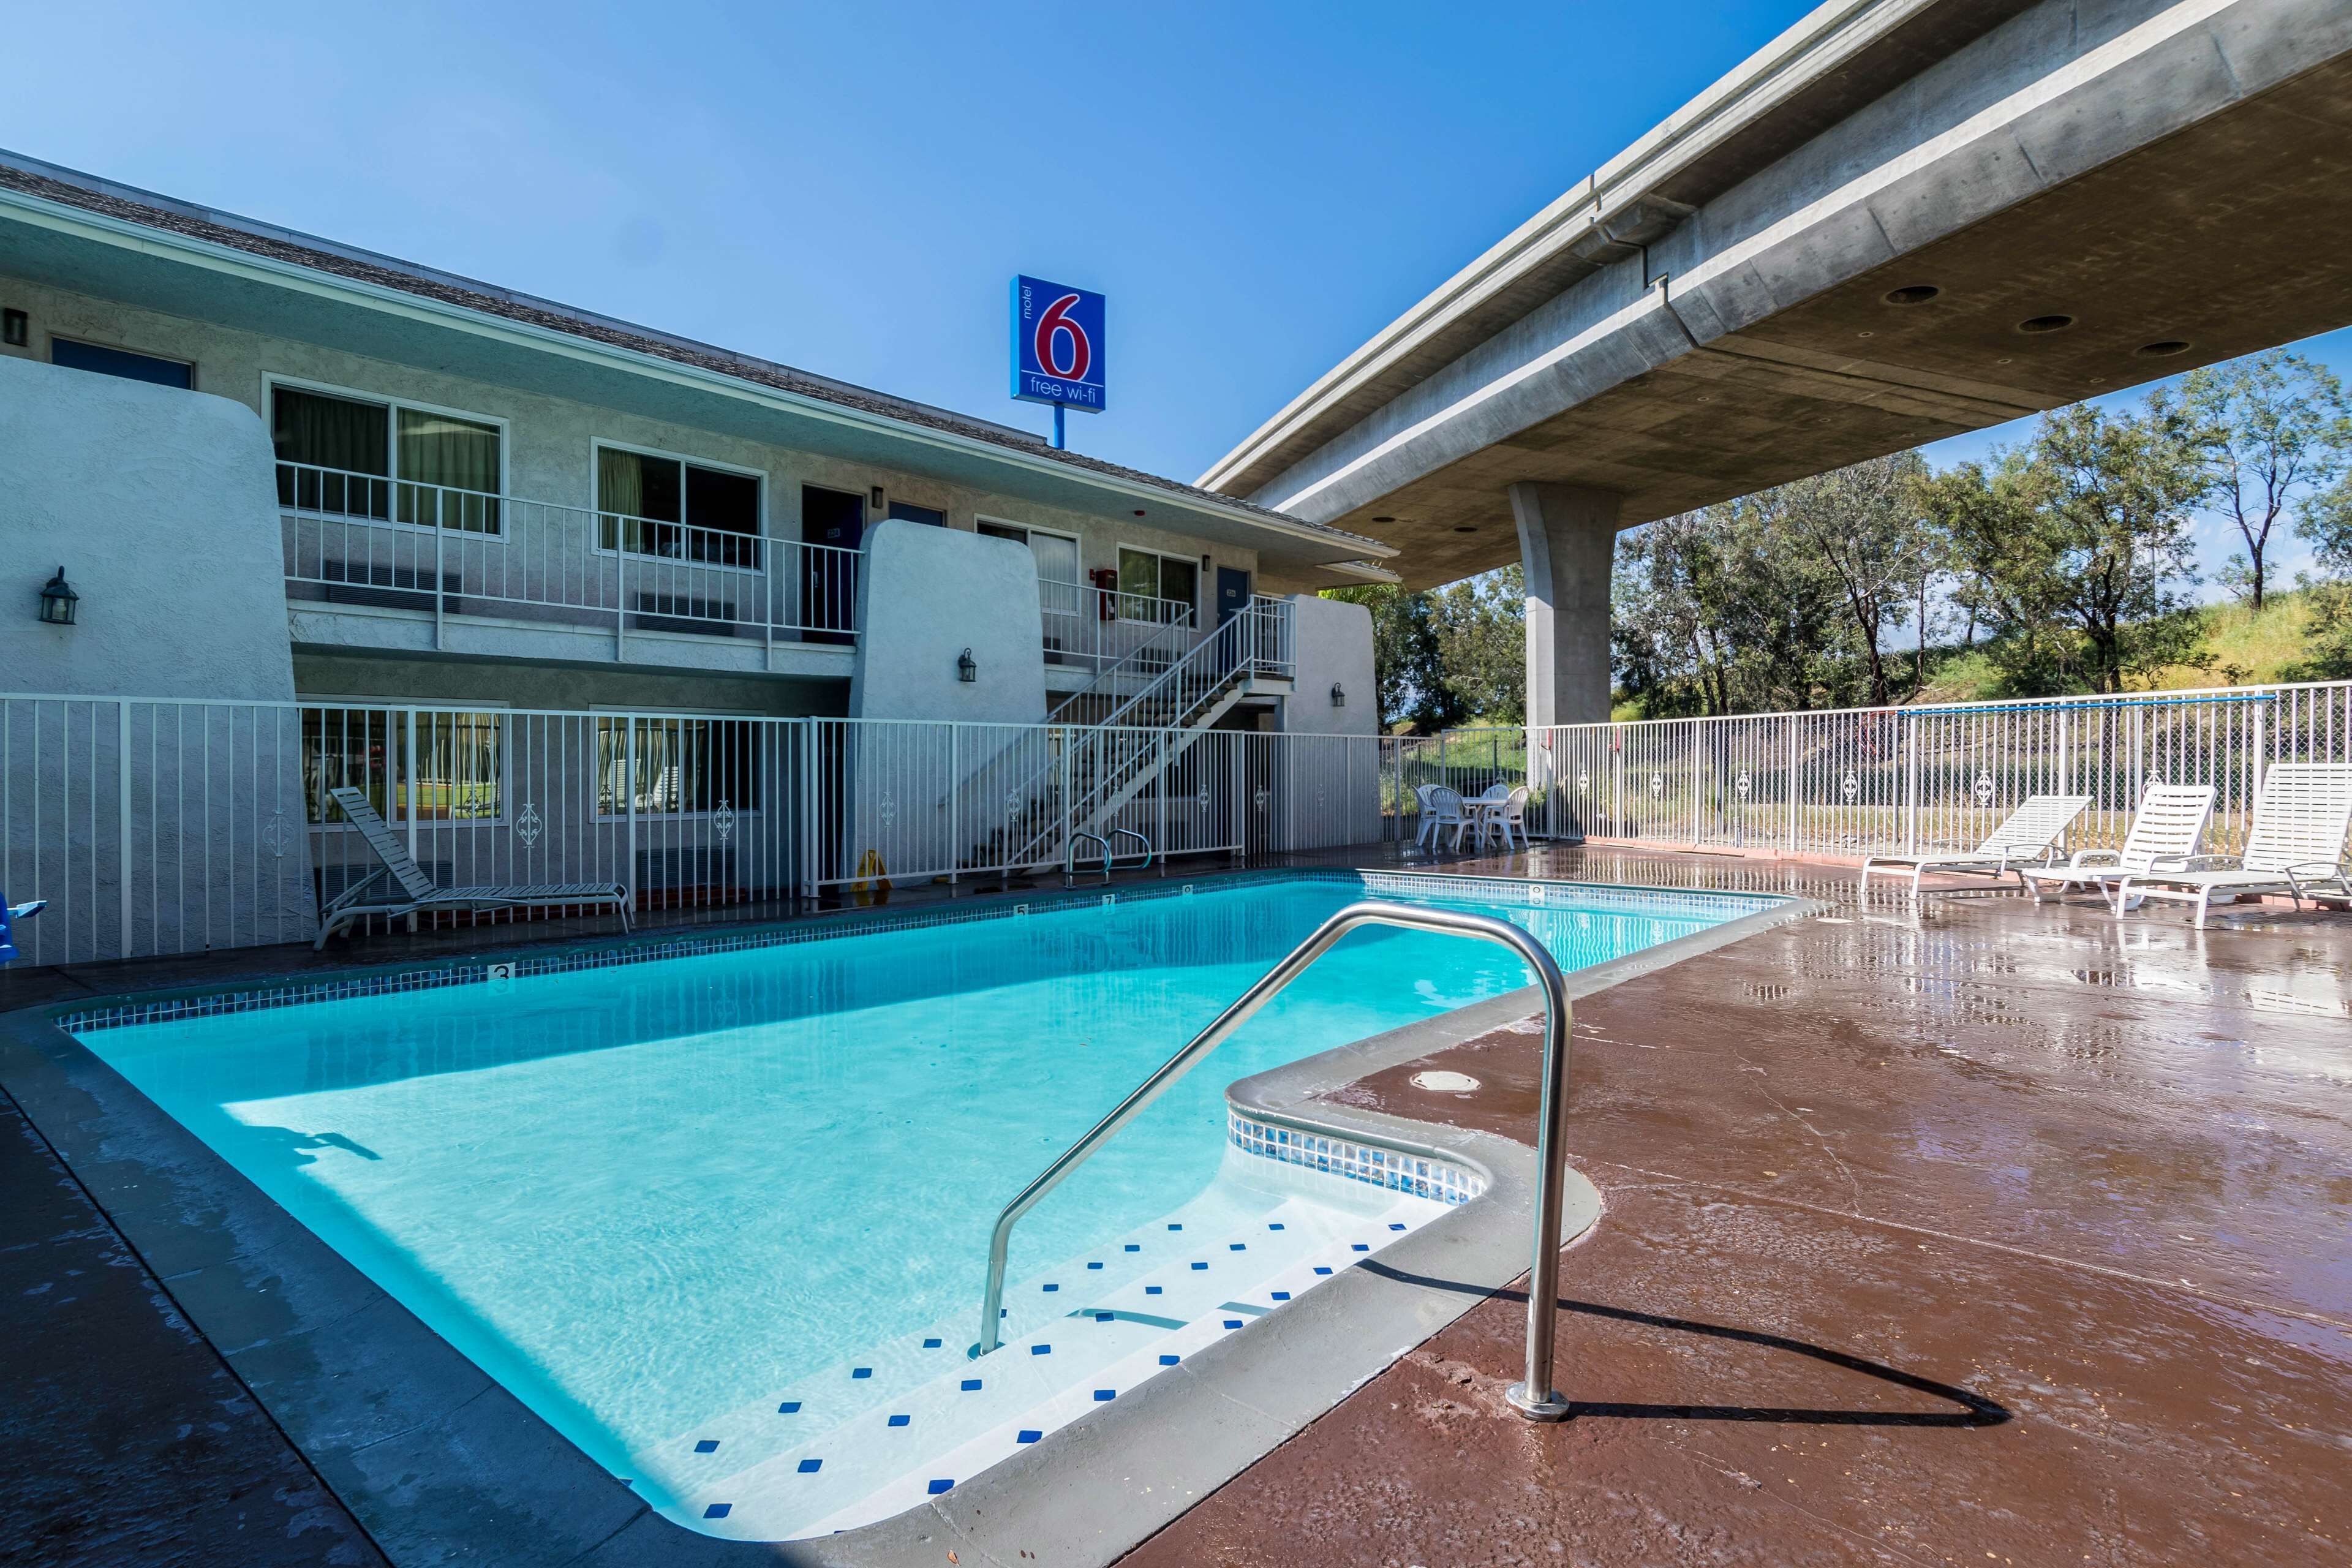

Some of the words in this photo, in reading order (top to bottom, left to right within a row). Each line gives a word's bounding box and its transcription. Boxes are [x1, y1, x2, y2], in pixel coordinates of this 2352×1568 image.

[1022, 285, 1031, 319] motel
[1035, 293, 1091, 382] 6
[1031, 377, 1062, 396] free
[1067, 385, 1096, 403] wi-fi
[1106, 895, 1112, 905] 7
[1017, 906, 1025, 916] 5
[494, 965, 510, 980] 3
